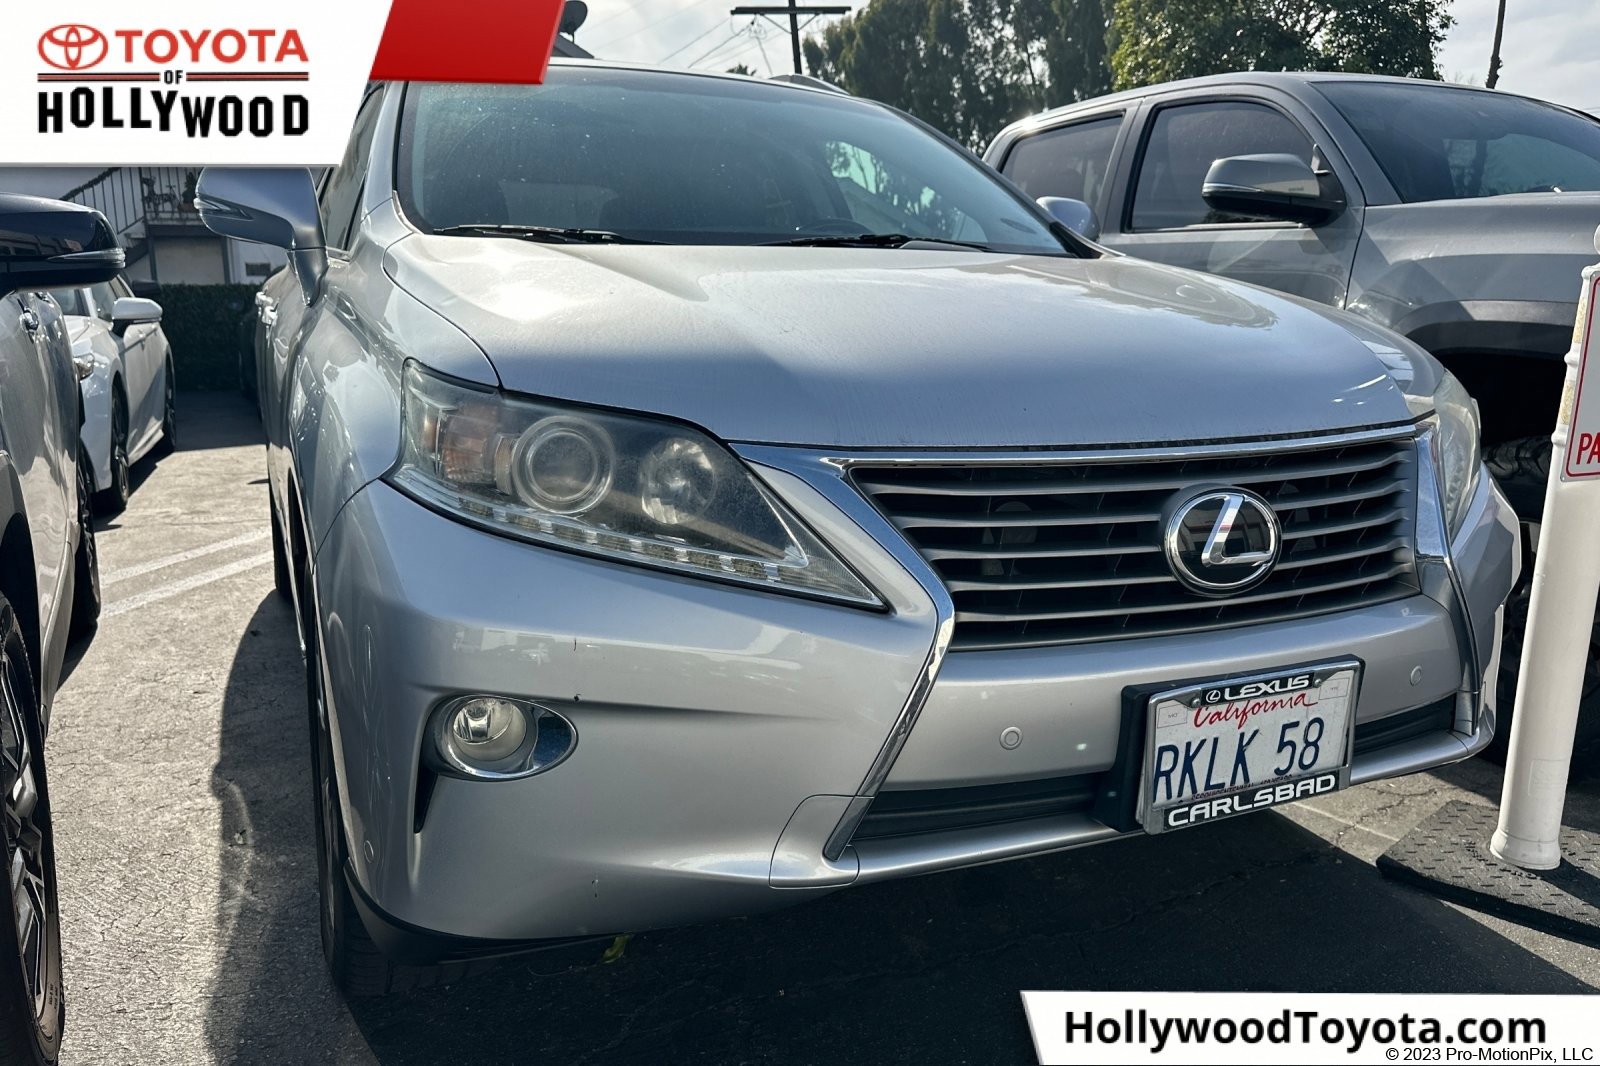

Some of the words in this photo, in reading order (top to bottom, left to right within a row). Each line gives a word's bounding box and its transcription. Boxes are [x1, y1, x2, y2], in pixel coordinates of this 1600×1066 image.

[1193, 692, 1318, 729] California
[1224, 674, 1310, 702] LEXUS
[1153, 728, 1260, 803] RKLK
[1273, 716, 1325, 777] 58
[1167, 773, 1336, 827] CARLSBAD
